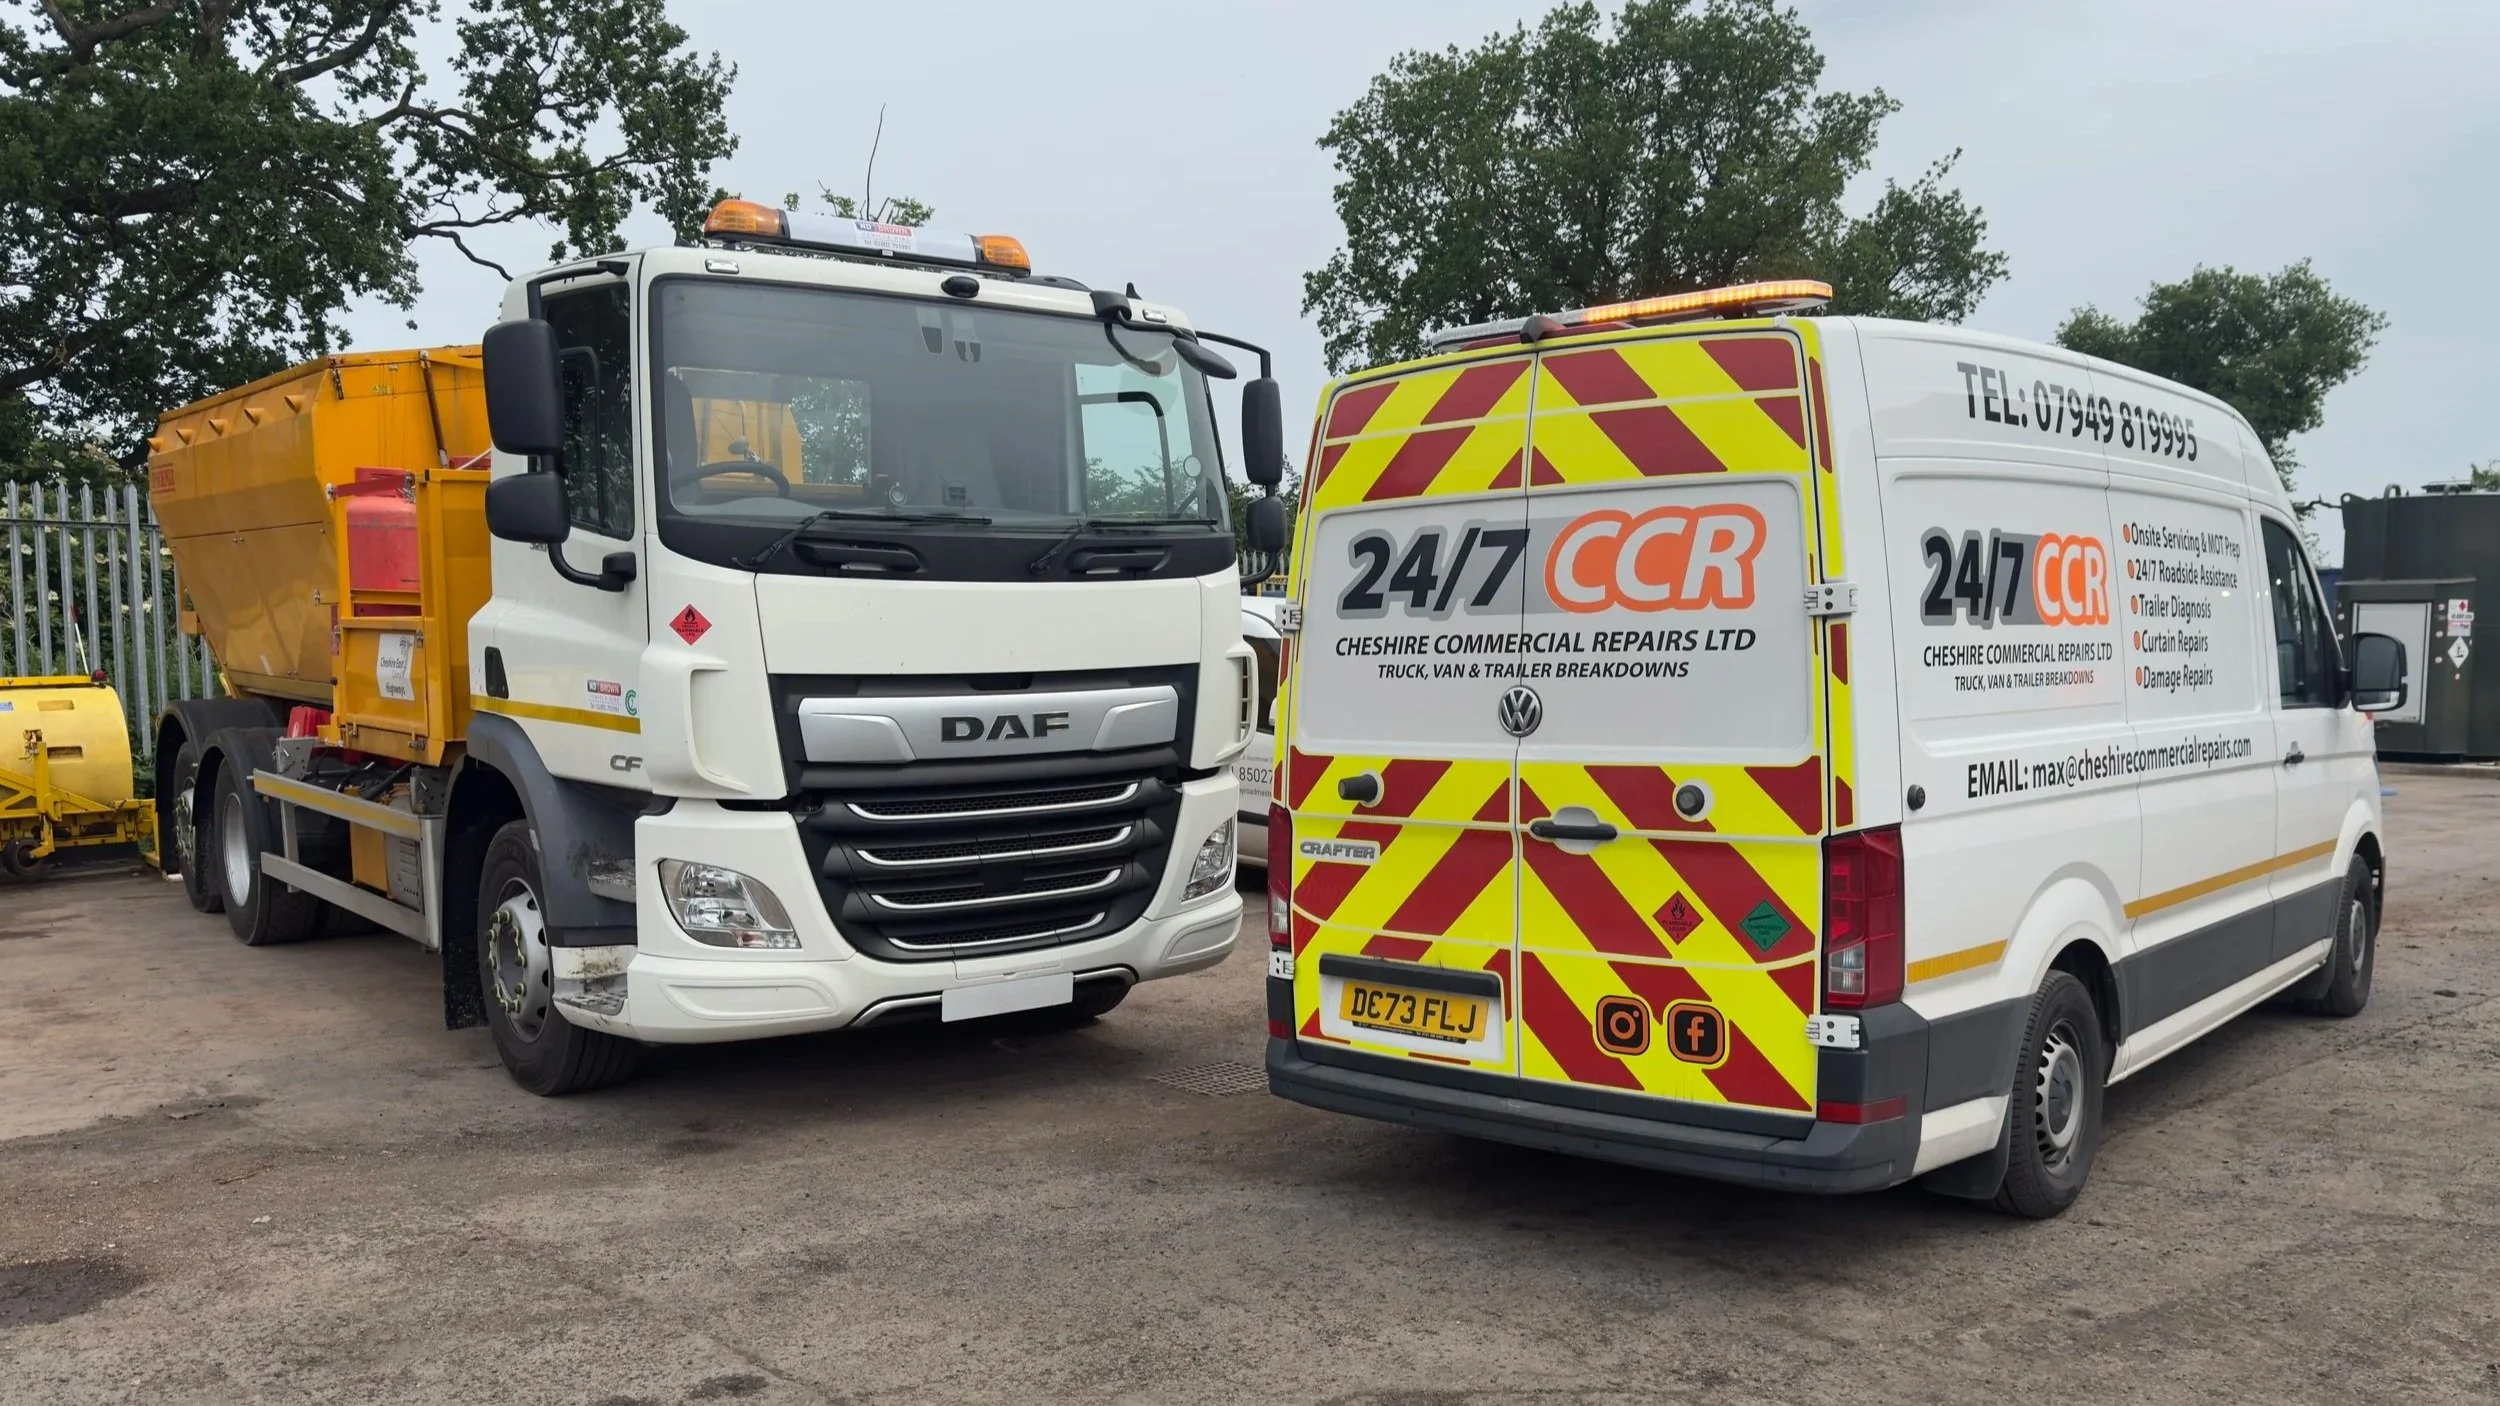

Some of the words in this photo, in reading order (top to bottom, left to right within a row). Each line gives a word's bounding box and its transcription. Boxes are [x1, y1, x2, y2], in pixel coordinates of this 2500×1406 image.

[877, 225, 909, 235] BROWN
[1957, 361, 2028, 428] TEL:
[2033, 380, 2115, 443] 07949
[2119, 401, 2198, 462] 819995
[2131, 522, 2161, 548] Onsite
[2162, 526, 2200, 558] Servicing
[2201, 532, 2207, 553] &
[2208, 532, 2223, 555] MOT
[2225, 536, 2240, 564] Prep
[1342, 527, 1530, 612] 24/7
[1545, 503, 1767, 614] CCR
[2135, 558, 2156, 581] 24/7
[2159, 560, 2198, 585] Roadside
[2200, 563, 2238, 589] Assistance
[1925, 535, 2024, 620] 24/7
[2033, 532, 2110, 627] CCR
[2139, 594, 2169, 617] Trailer
[2171, 595, 2211, 624] Diagnosis
[1336, 635, 1429, 656] CHESHIRE
[1434, 632, 1585, 655] COMMERCIAL
[1592, 630, 1698, 653] REPAIRS
[1705, 629, 1756, 651] LTD
[1924, 645, 1984, 667] CHESHIRE
[1986, 643, 2056, 665] COMMERCIAL
[2058, 643, 2095, 662] REPAIRS
[2097, 642, 2112, 661] LTD
[2142, 629, 2176, 653] Curtain
[2178, 629, 2208, 658] Repairs
[1378, 664, 1429, 681] TRUCK,
[1433, 664, 1465, 678] VAN
[1468, 664, 1481, 678] &
[1484, 663, 1552, 678] TRAILER
[1555, 662, 1689, 678] BREAKDOWNS
[1955, 675, 1986, 692] TRUCK,
[1987, 674, 2005, 690] VAN
[2006, 674, 2012, 689] &
[2014, 672, 2044, 688] TRAILER
[2045, 670, 2094, 686] BREAKDOWNS
[2143, 665, 2181, 694] Damage
[2183, 663, 2213, 692] Repairs
[600, 683, 620, 694] BROWN
[941, 711, 1069, 742] DAF
[610, 755, 643, 772] CF
[1968, 758, 2028, 799] EMAIL:
[2033, 734, 2252, 788] max@cheshirecommercialrepairs.com
[1300, 841, 1375, 859] CRAFTER
[1422, 998, 1477, 1034] FLJ
